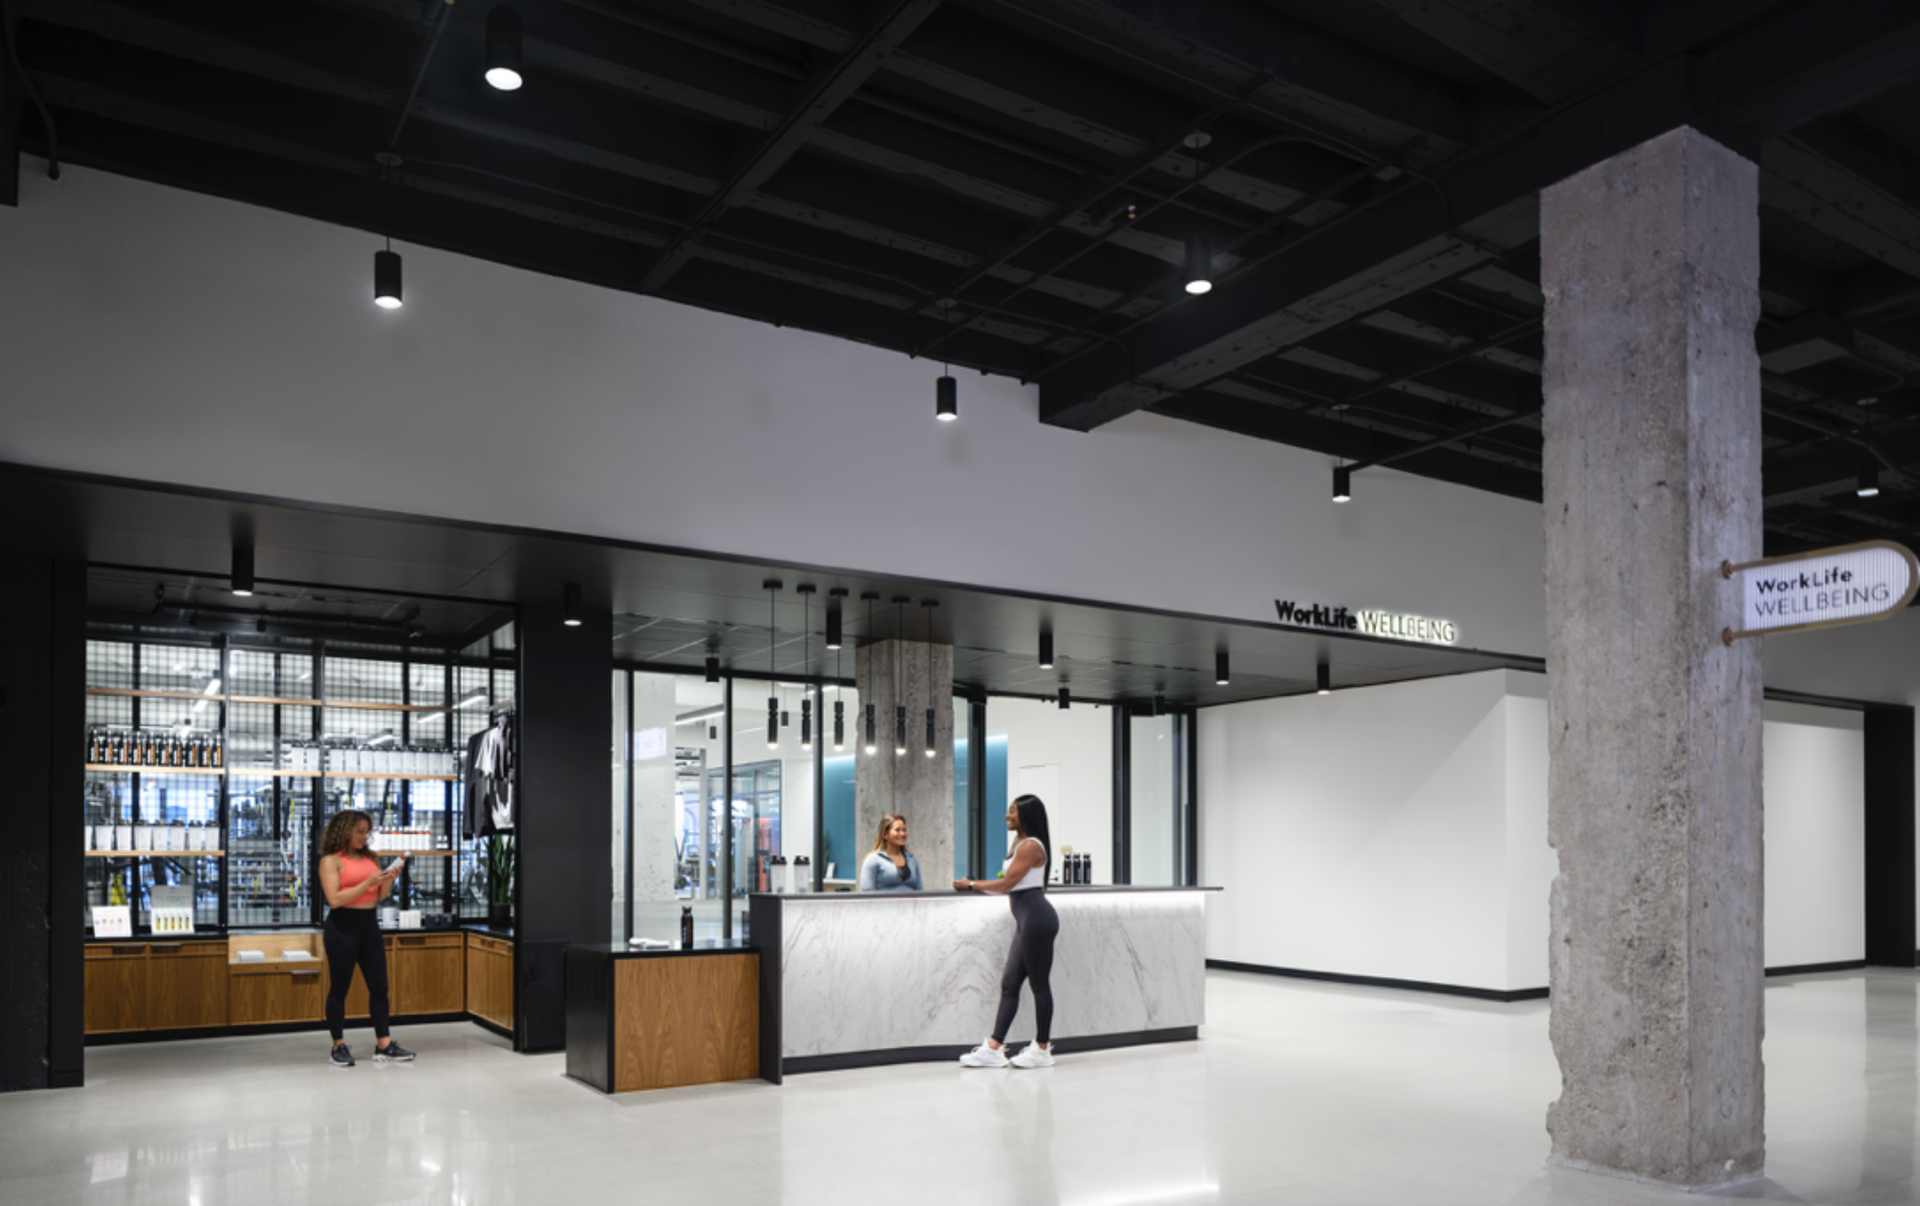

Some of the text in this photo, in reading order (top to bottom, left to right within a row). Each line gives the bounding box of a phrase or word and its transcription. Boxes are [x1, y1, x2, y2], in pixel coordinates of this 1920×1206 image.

[1756, 567, 1852, 594] WorkLife
[1755, 583, 1890, 617] WELLBEING
[1275, 599, 1455, 642] WorkLife WELLBEING
